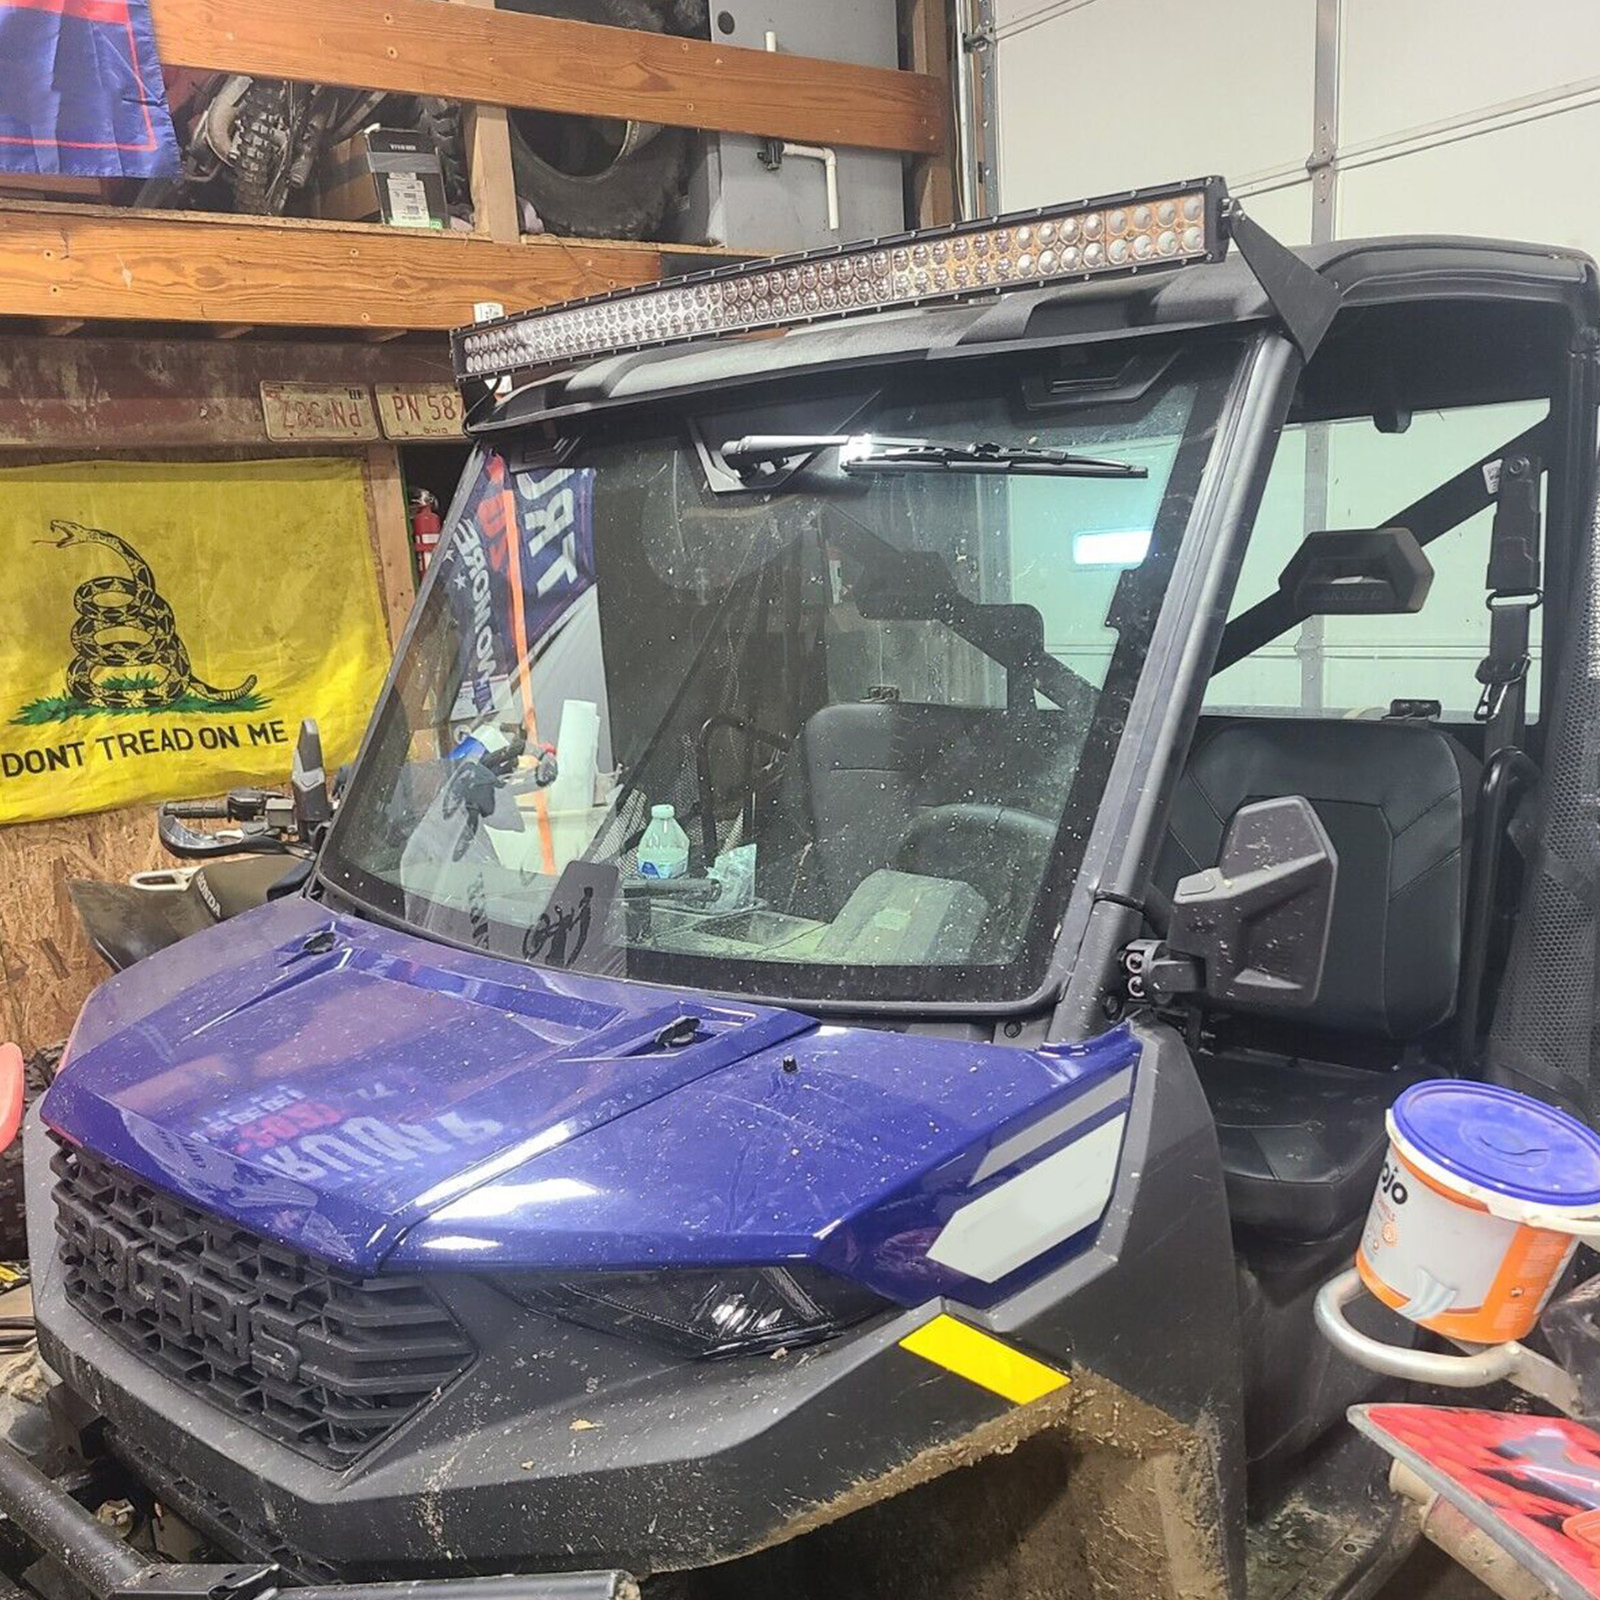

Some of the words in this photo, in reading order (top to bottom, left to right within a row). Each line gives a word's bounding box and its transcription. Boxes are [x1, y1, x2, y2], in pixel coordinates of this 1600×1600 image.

[391, 394, 422, 423] PN
[423, 426, 449, 435] OHIO
[2, 741, 85, 777] DONT
[96, 728, 195, 761] TREAD
[199, 726, 241, 749] ON
[250, 720, 289, 746] ME
